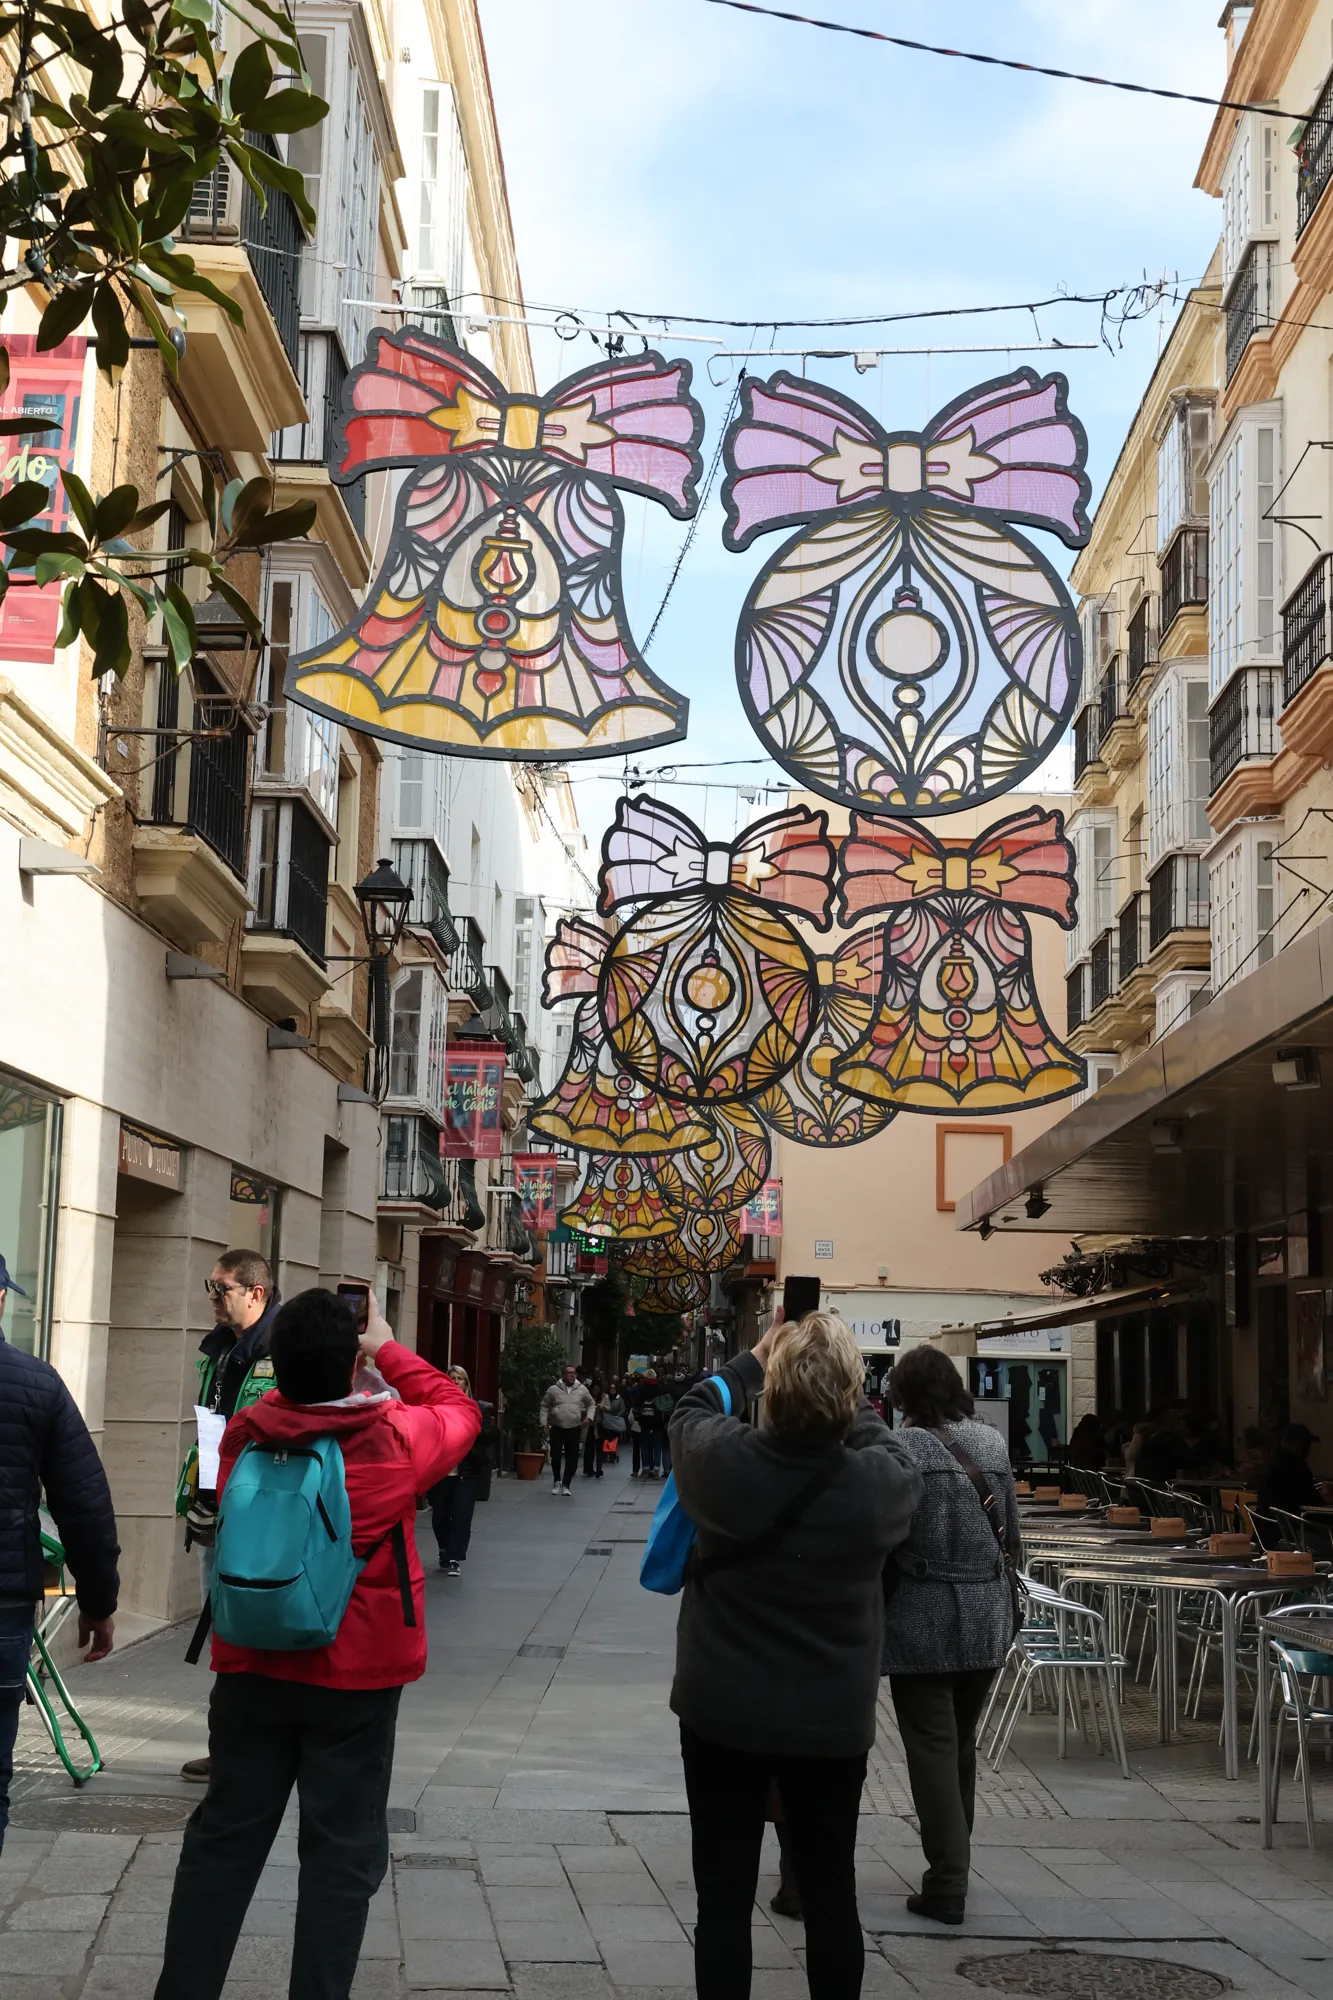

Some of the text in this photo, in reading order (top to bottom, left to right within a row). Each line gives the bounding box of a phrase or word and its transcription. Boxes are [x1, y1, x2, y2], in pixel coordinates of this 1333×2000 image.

[10, 406, 53, 415] ABIERTO
[462, 1079, 498, 1098] latido
[444, 1096, 497, 1112] de Cádiz
[122, 1136, 143, 1165] PUNT
